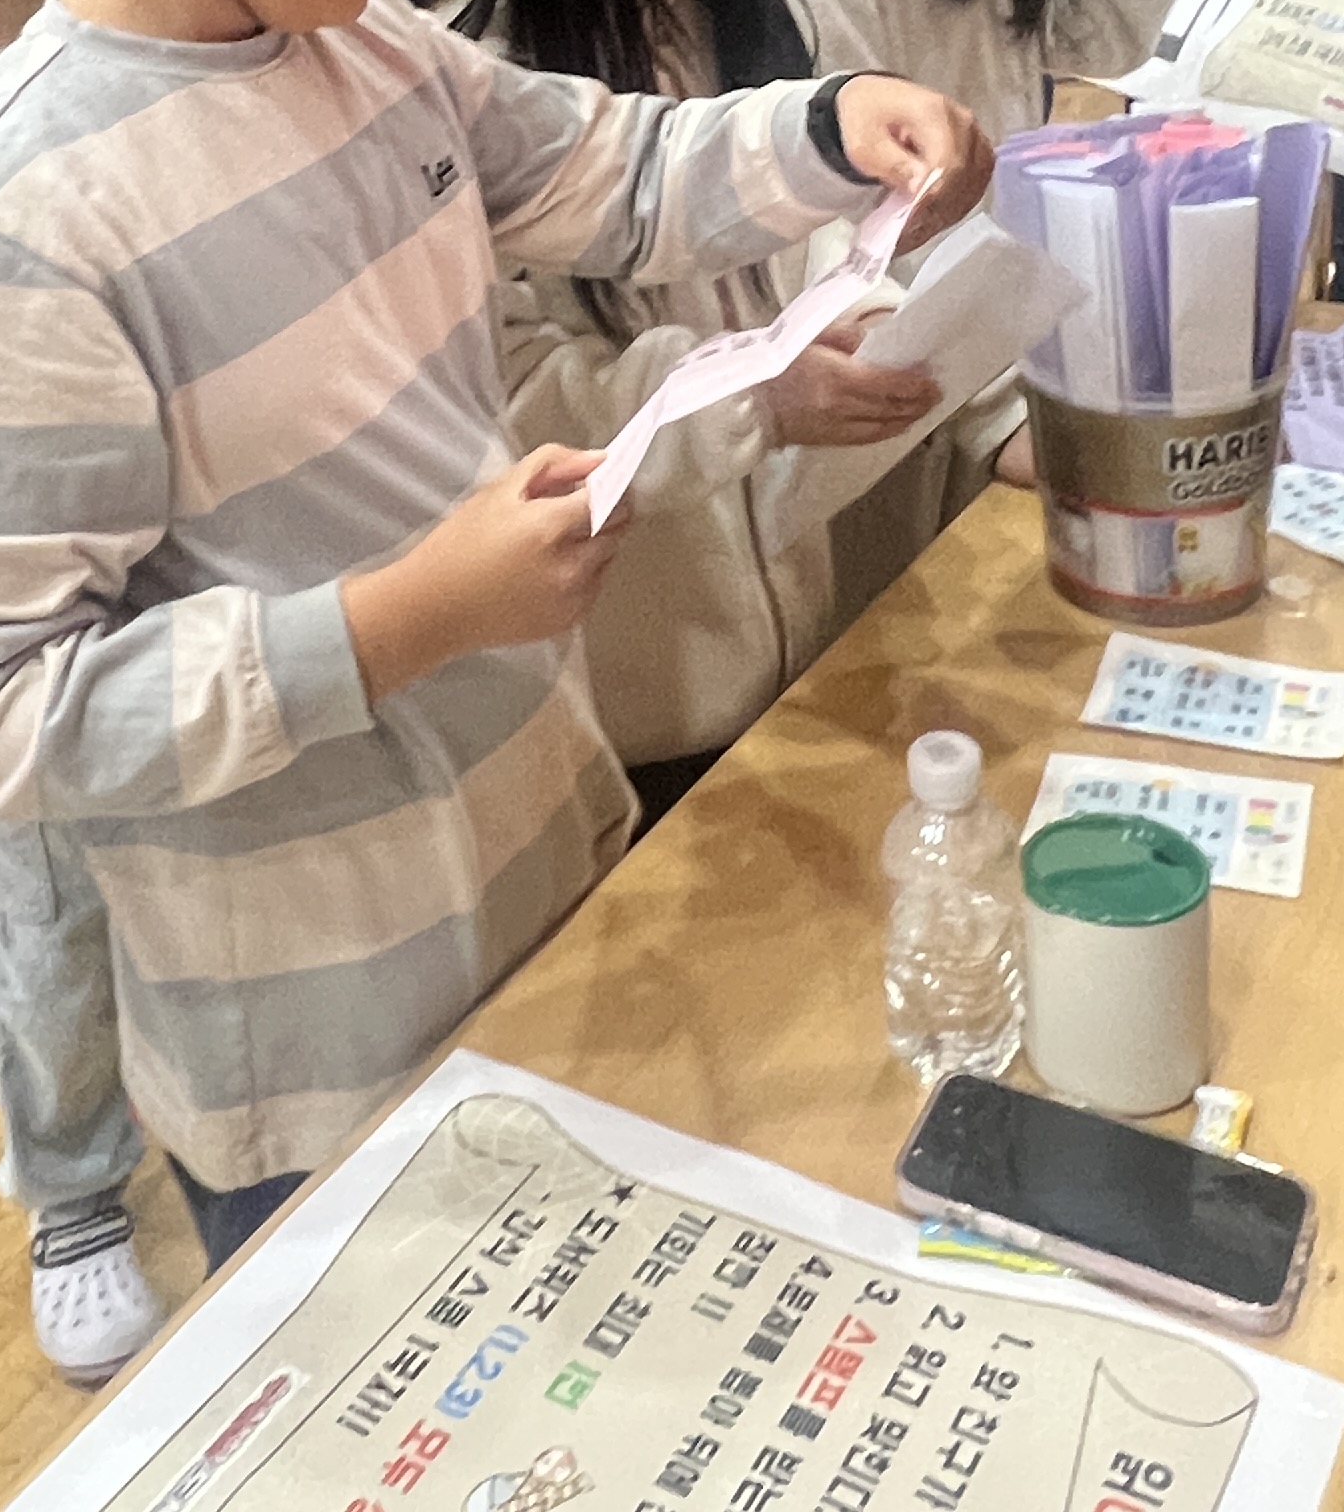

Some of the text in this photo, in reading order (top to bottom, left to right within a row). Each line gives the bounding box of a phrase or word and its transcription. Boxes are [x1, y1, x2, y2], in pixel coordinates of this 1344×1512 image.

[1168, 425, 1271, 471] HARIB
[509, 1207, 621, 1324] 도서퀴즈
[854, 1279, 901, 1305] 3.
[583, 1291, 653, 1360] 최대
[920, 1303, 966, 1331] 2.
[880, 1344, 948, 1409] 읽고
[914, 1332, 1035, 1511] 1. 앞 친구가
[381, 1417, 452, 1496] 모두
[1101, 1449, 1175, 1512] 읽
